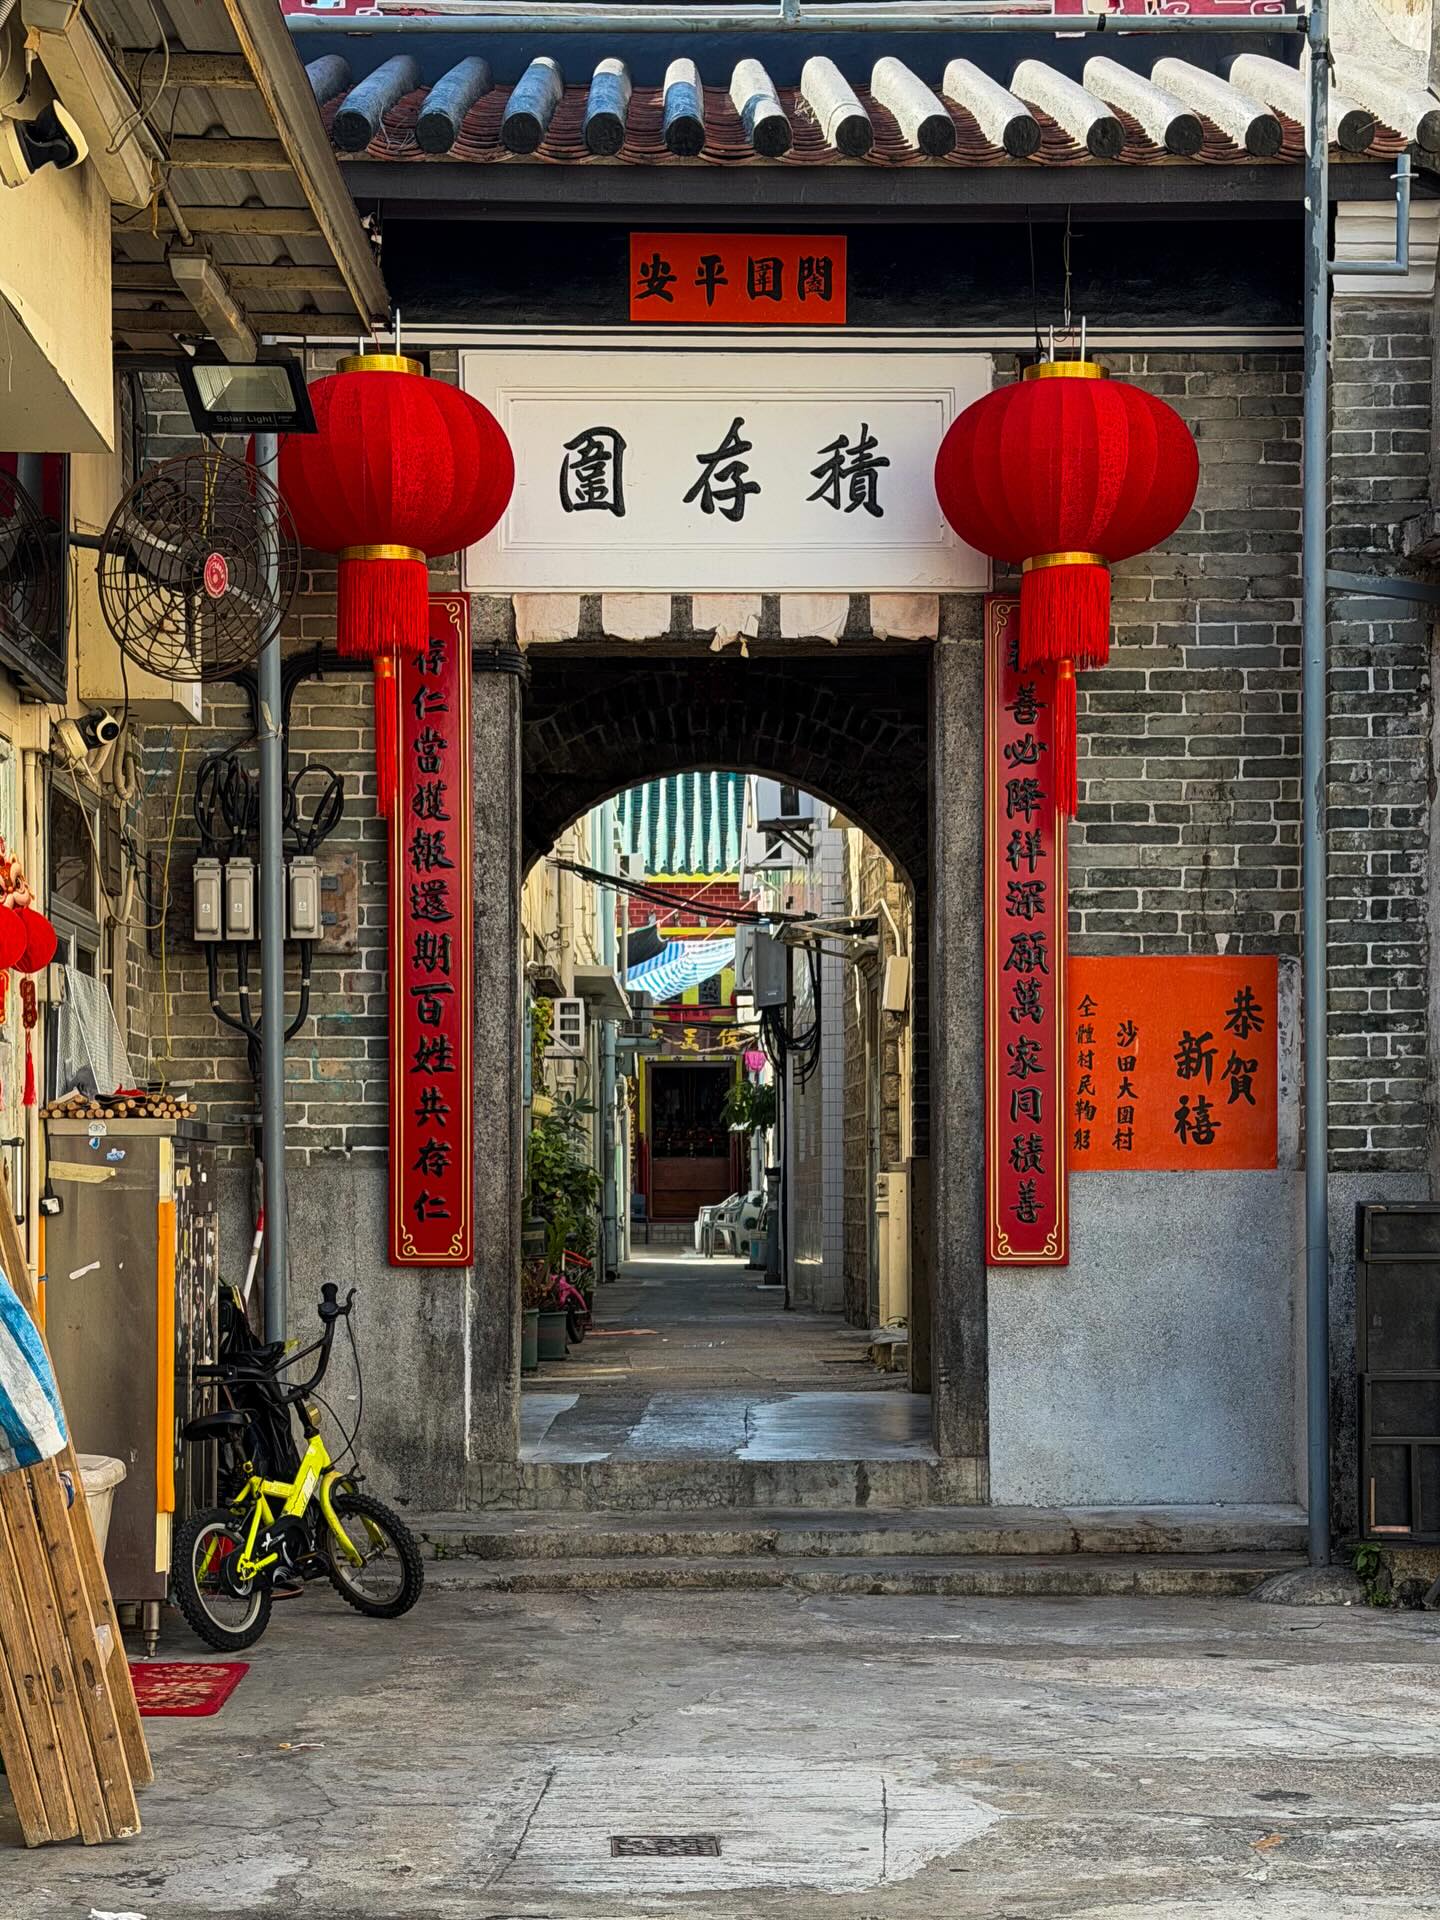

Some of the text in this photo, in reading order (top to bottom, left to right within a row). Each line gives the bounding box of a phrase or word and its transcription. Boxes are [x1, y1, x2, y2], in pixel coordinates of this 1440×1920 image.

[216, 415, 243, 424] Solar
[246, 415, 273, 425] Light
[1073, 993, 1099, 1152] 全體村民鞠躬
[1111, 1019, 1140, 1152] 沙田大圍村
[1173, 1030, 1223, 1146] 新禧
[1220, 984, 1265, 1106] 恭賀
